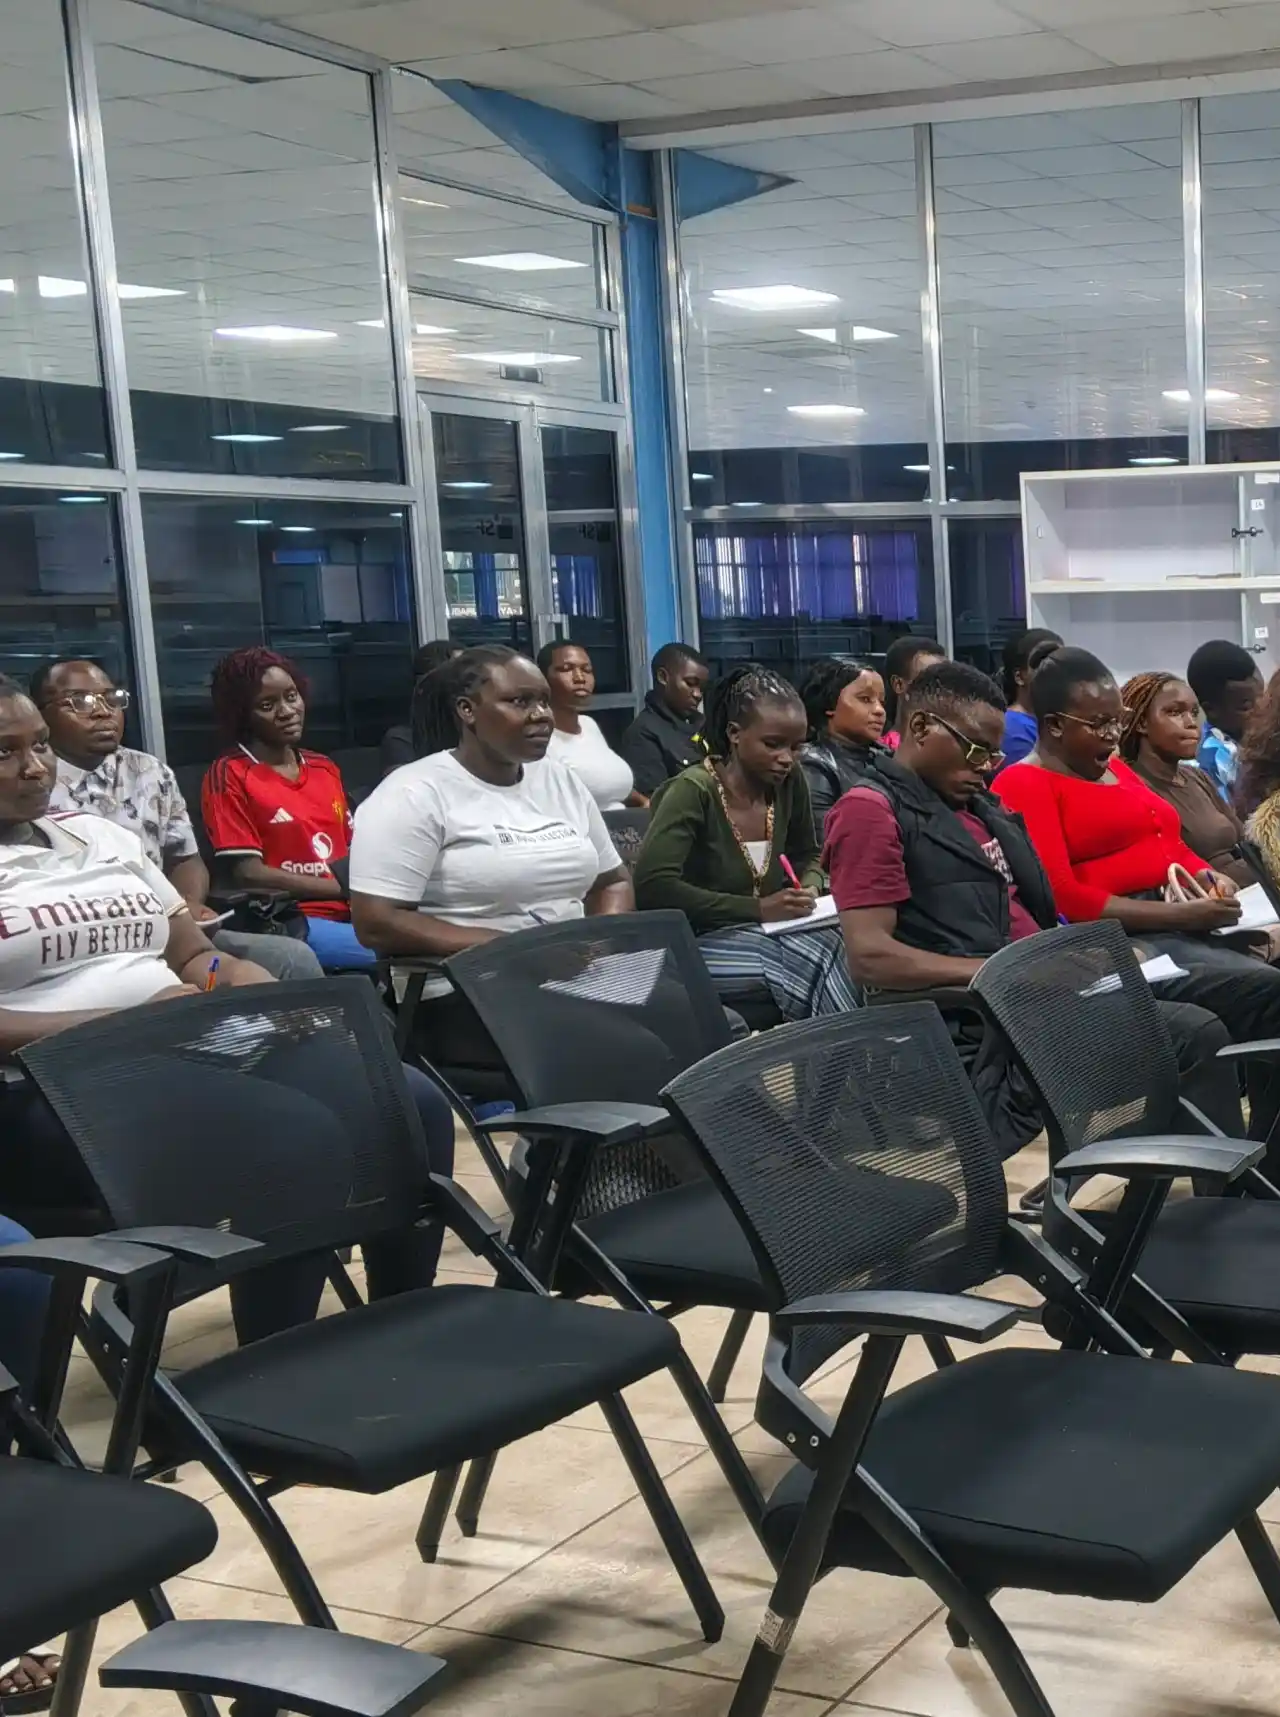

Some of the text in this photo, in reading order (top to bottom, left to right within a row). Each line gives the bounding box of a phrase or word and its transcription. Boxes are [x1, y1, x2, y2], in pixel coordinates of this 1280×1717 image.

[280, 860, 332, 877] Snap
[0, 888, 165, 941] Emirates
[41, 922, 153, 965] FLY BETTER
